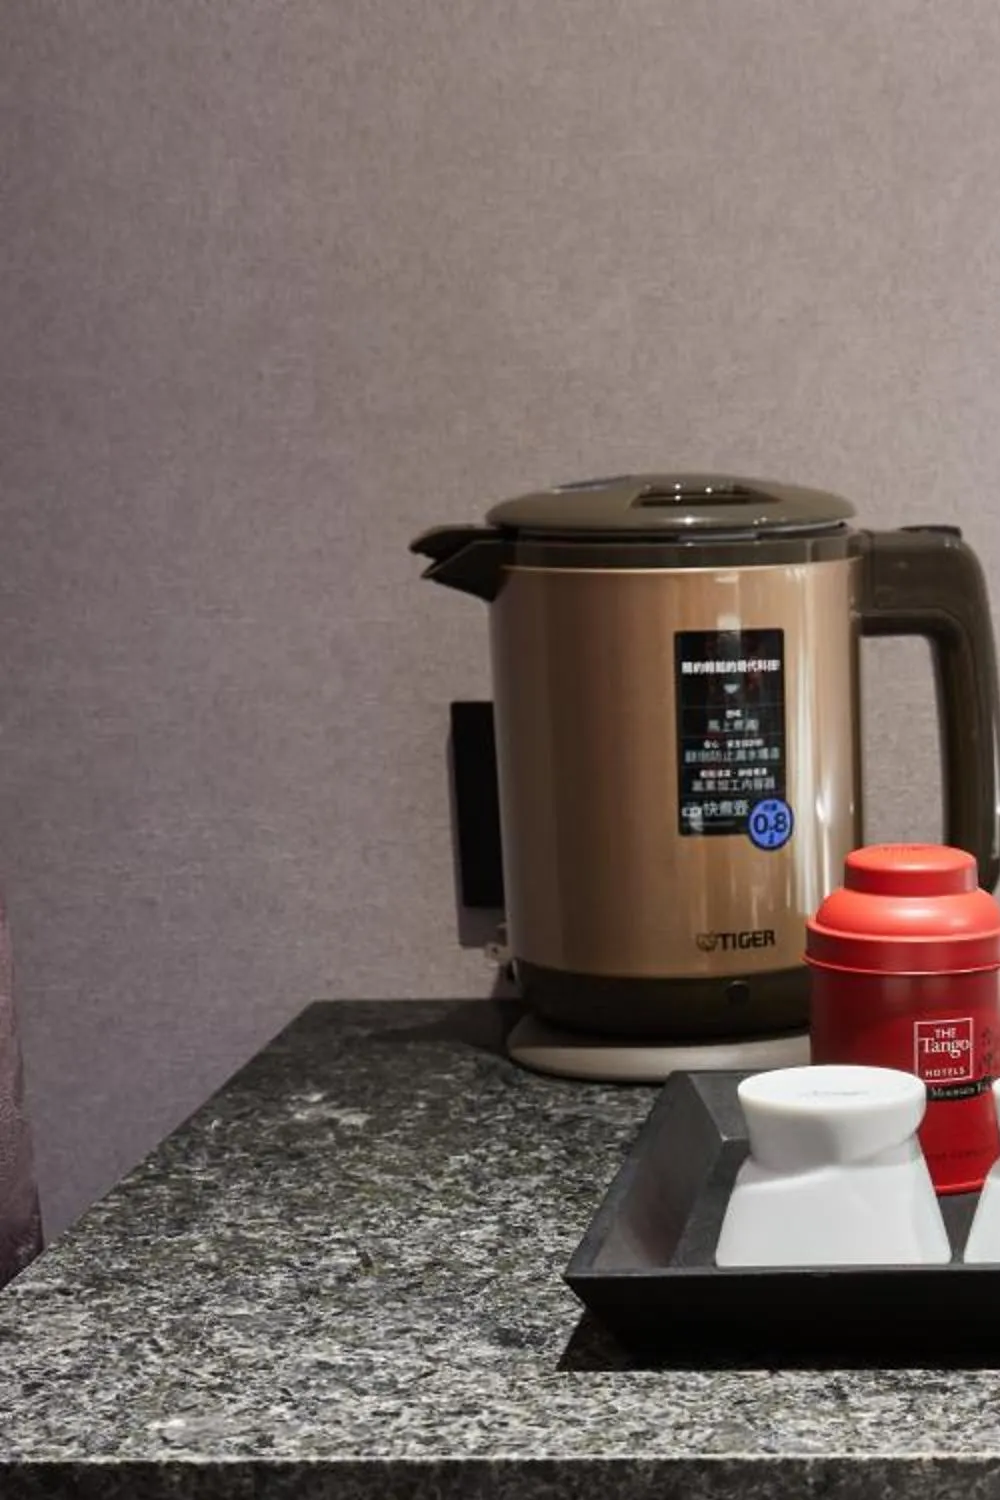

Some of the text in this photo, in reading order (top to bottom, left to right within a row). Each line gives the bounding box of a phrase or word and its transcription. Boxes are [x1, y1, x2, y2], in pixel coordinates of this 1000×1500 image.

[753, 811, 787, 835] 0.8
[716, 929, 776, 952] TIGER
[934, 1027, 957, 1039] THE
[919, 1037, 970, 1059] Tango
[925, 1066, 966, 1078] HOTELS
